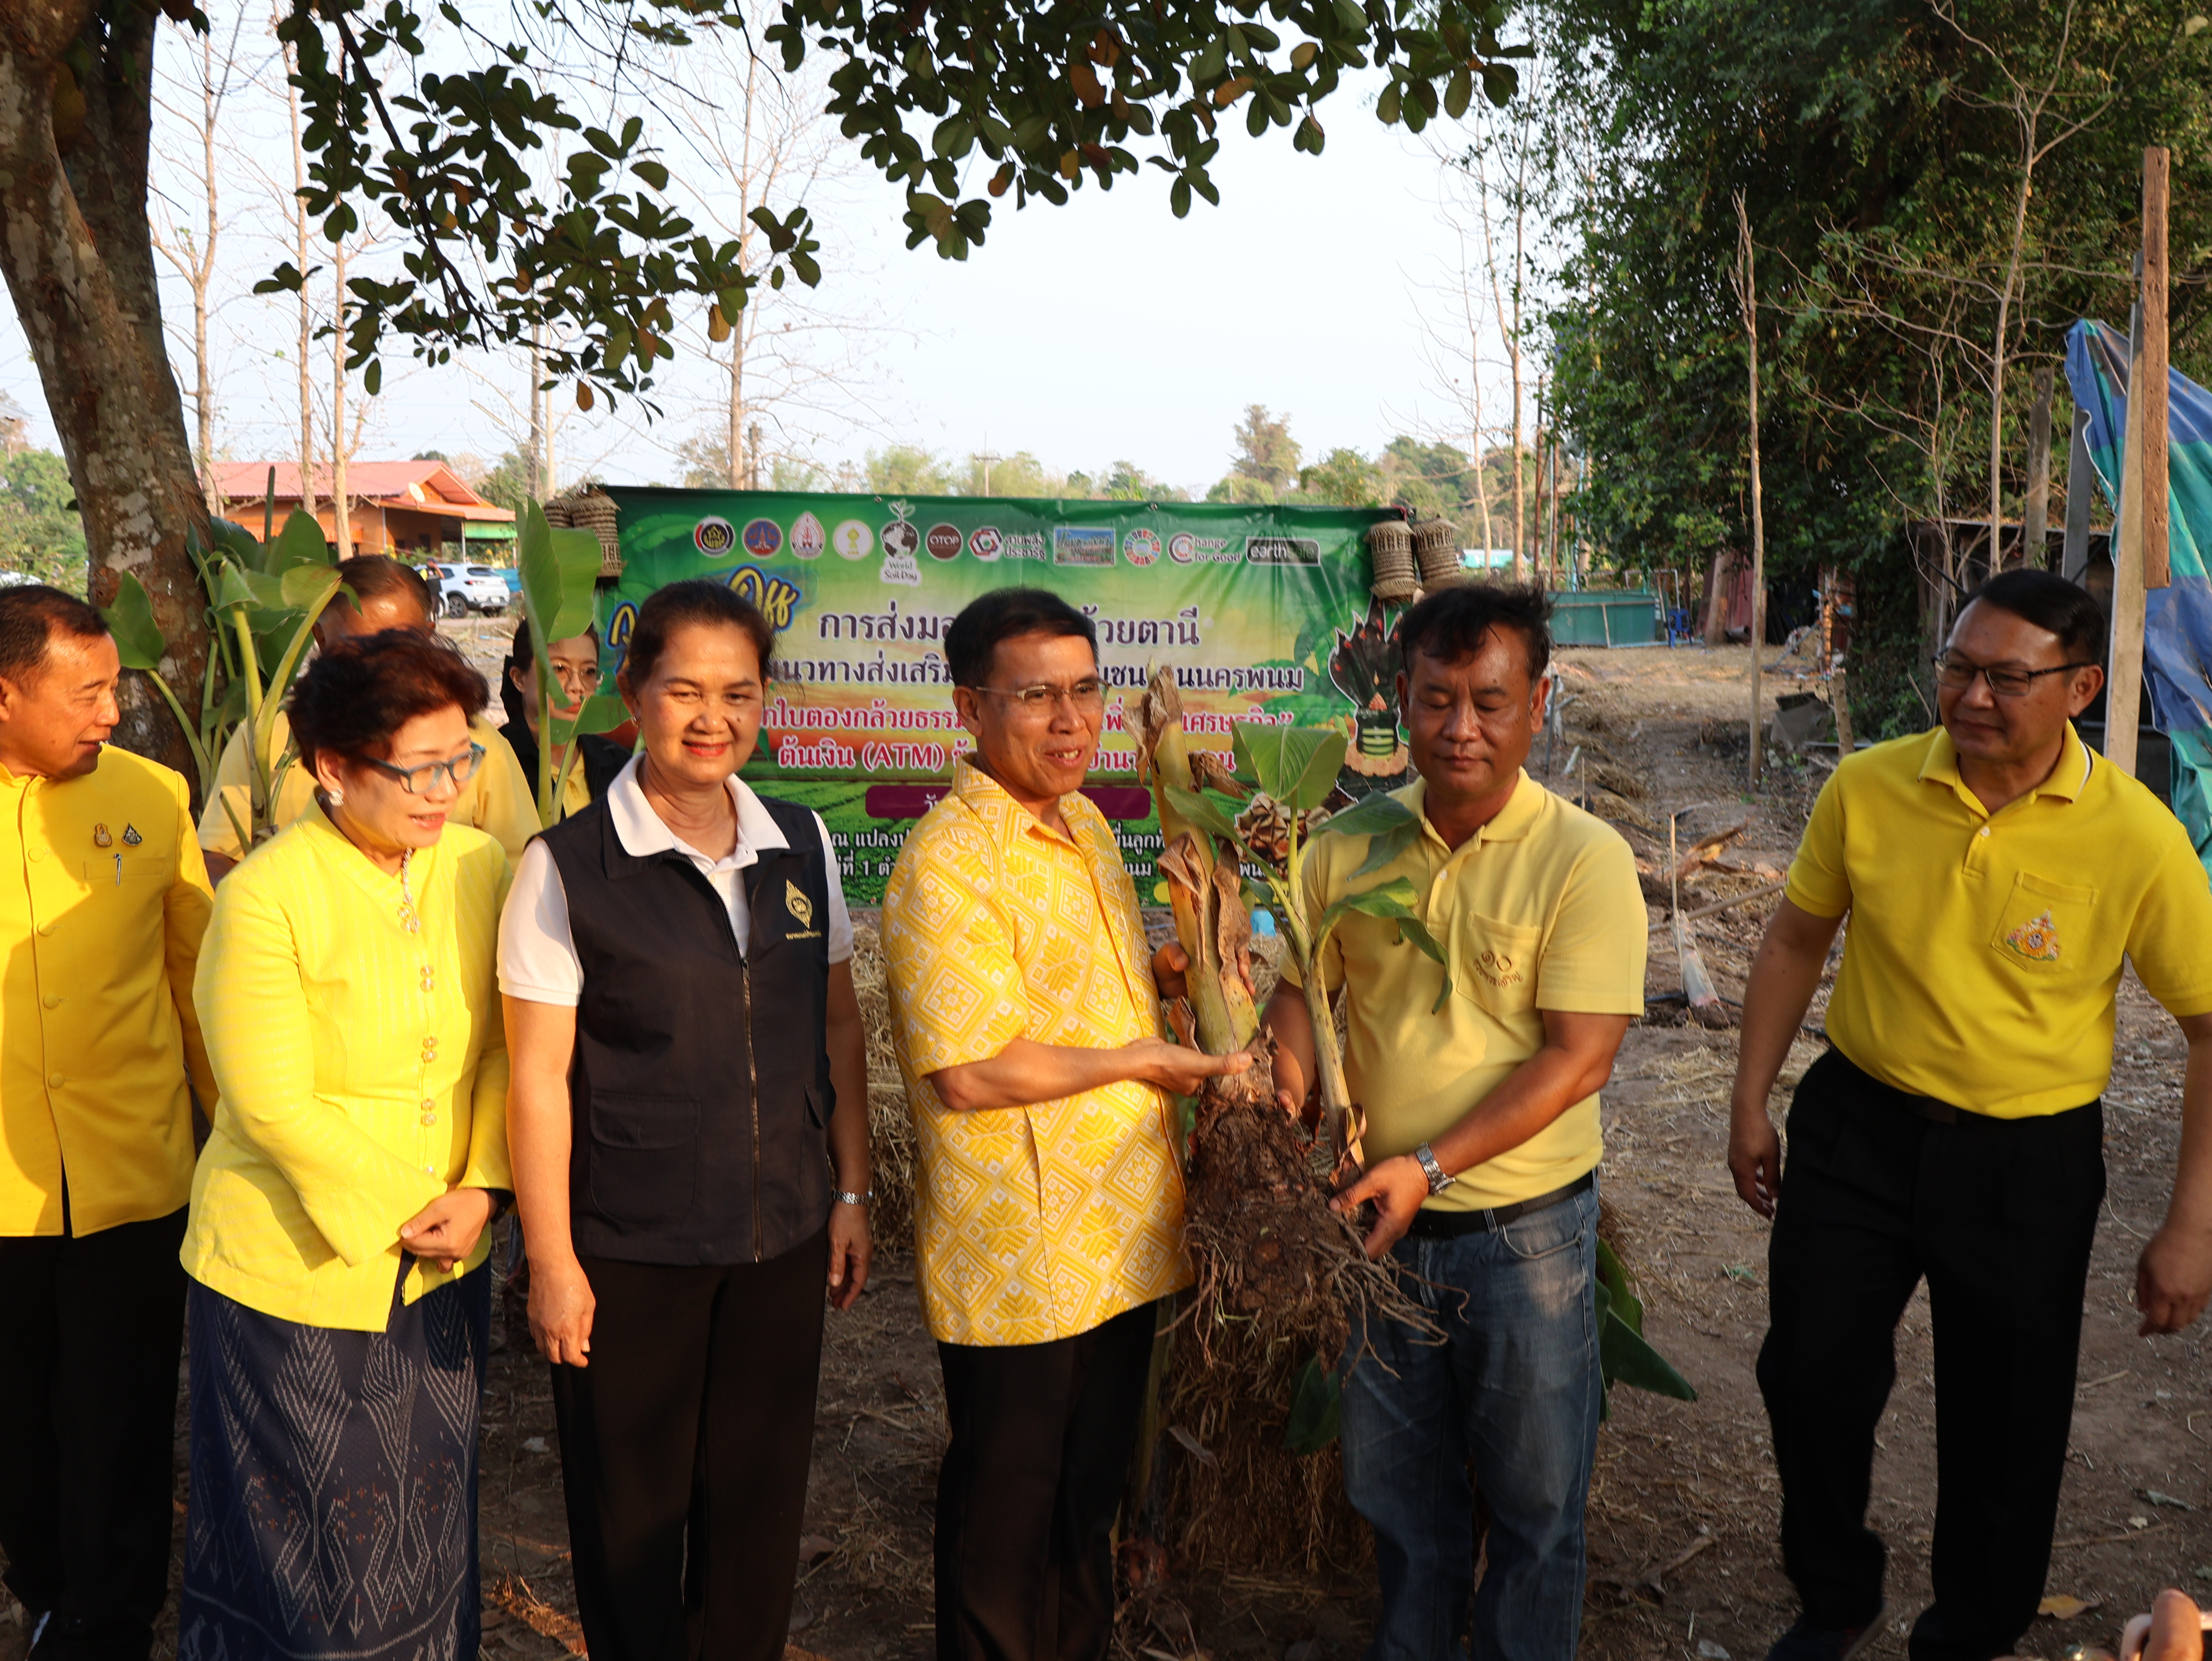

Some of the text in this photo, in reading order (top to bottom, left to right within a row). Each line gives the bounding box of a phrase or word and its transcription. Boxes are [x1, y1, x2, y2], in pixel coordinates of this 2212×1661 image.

[930, 535, 959, 545] OTOP
[1194, 551, 1241, 562] for Good
[888, 560, 912, 570] World
[884, 570, 917, 582] Soil Day
[1082, 605, 1200, 645] ้วยตานี
[1175, 666, 1304, 688] นนครพนม
[780, 736, 854, 767] ต้นเงิน
[862, 743, 945, 772] (ATM)
[862, 860, 869, 877] 1
